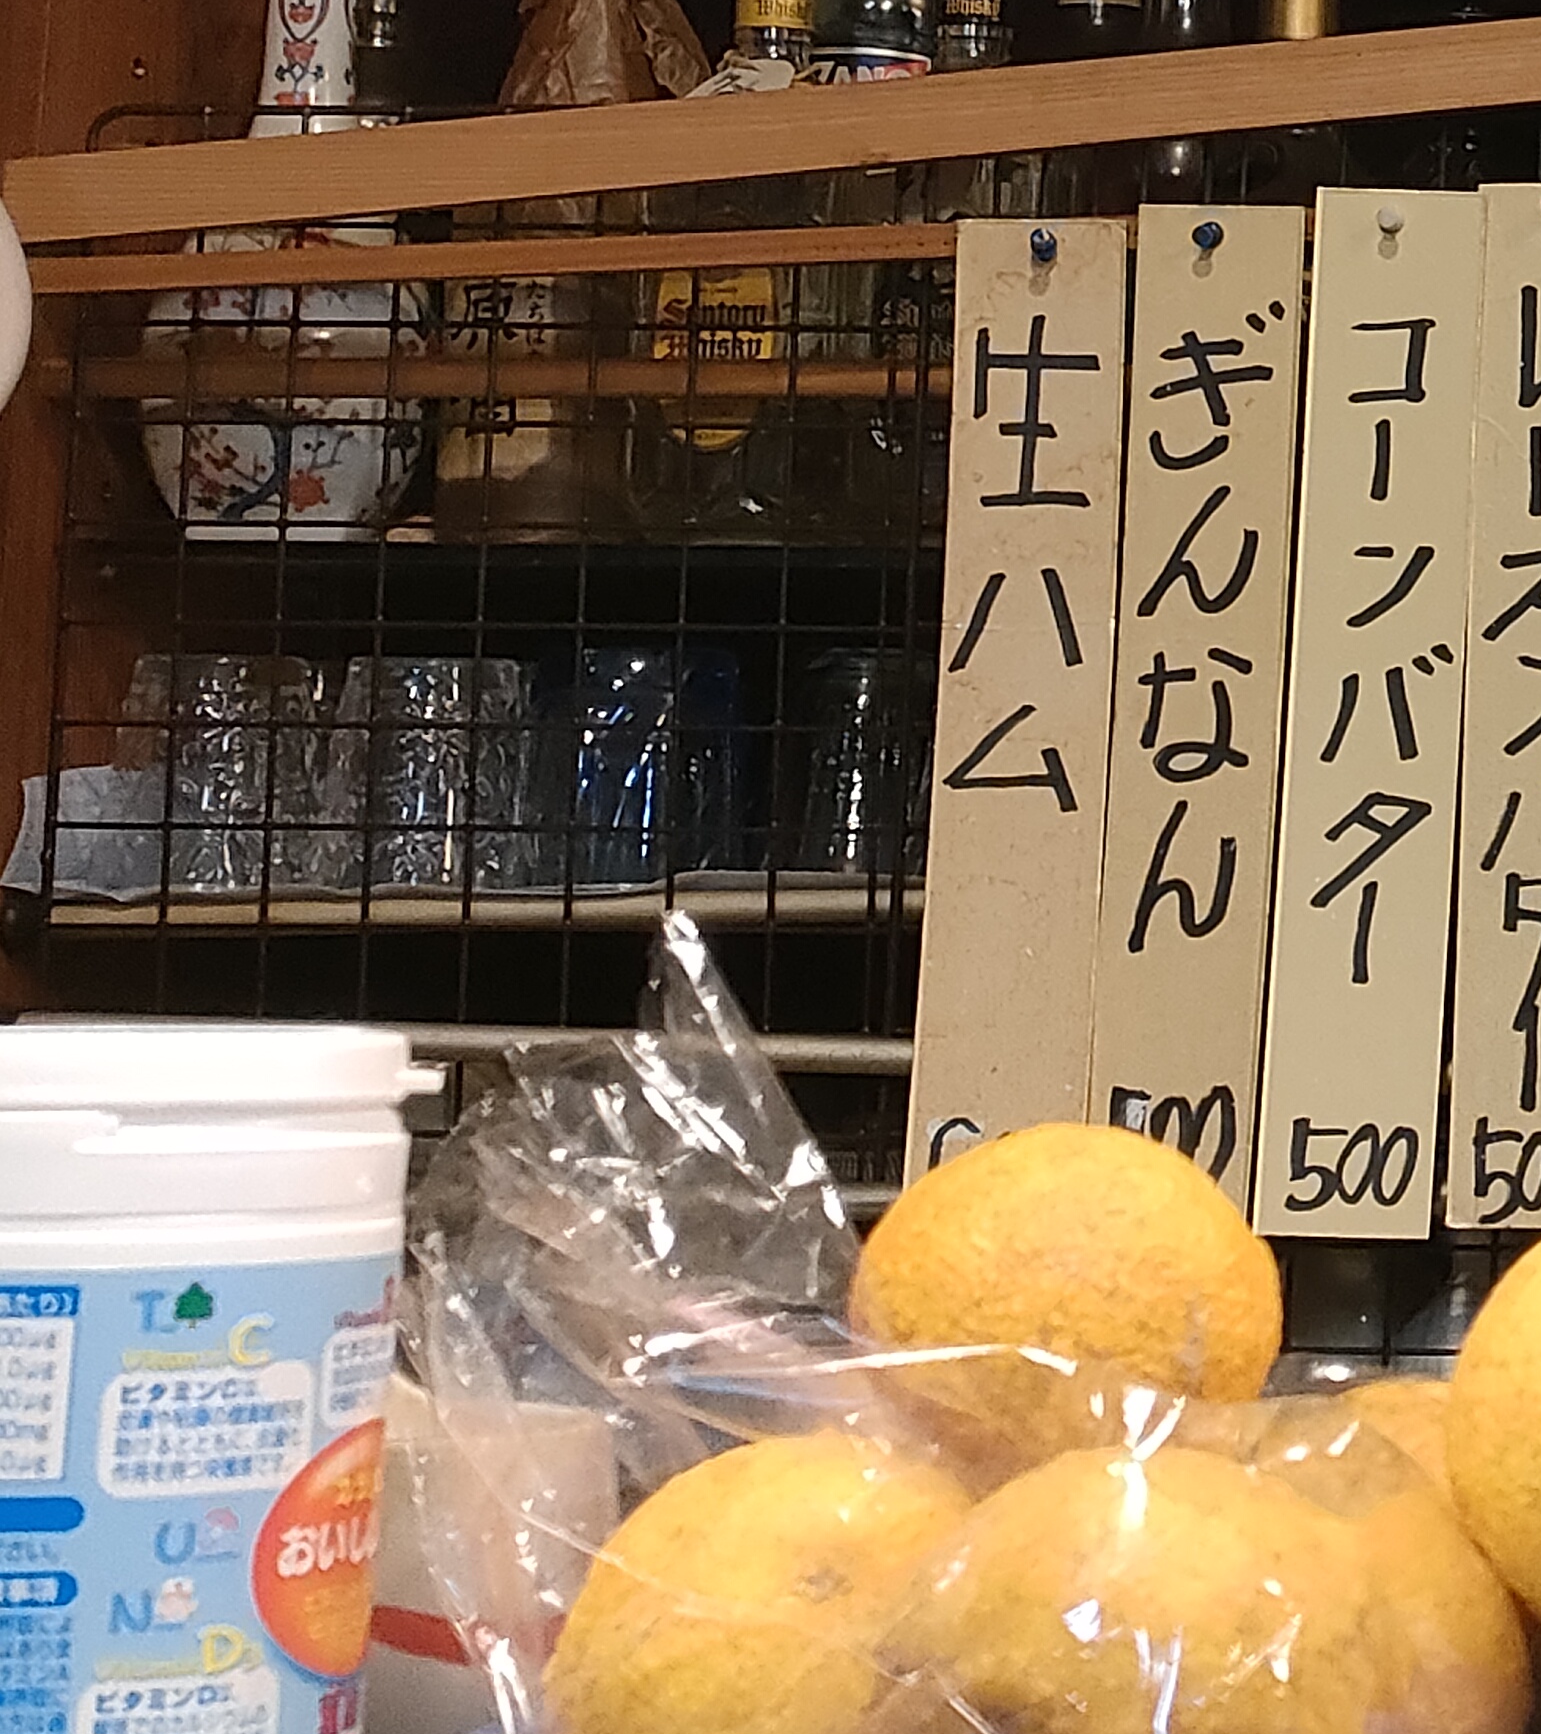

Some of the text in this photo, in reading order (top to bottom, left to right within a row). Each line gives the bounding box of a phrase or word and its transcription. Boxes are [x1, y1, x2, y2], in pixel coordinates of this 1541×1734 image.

[942, 314, 1101, 815] 生ハム
[1127, 301, 1287, 955] ぎんなん
[1309, 319, 1455, 986] コーンバター
[1285, 1115, 1419, 1212] 500
